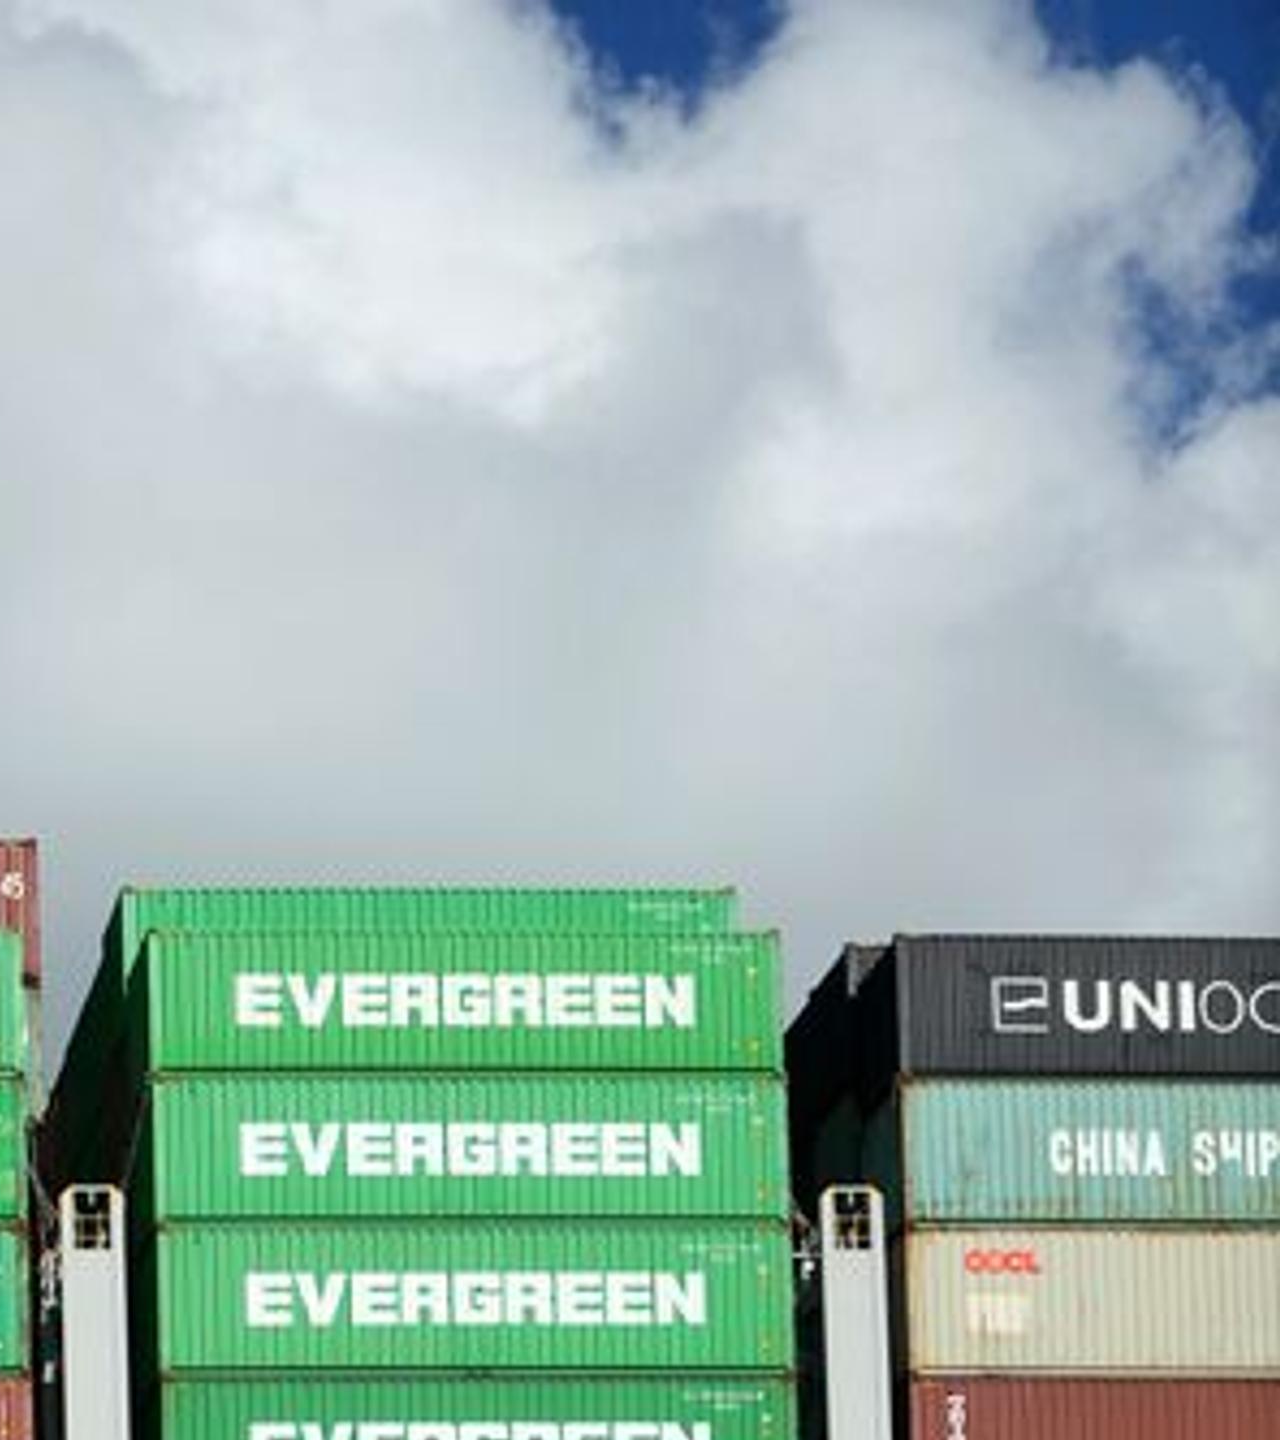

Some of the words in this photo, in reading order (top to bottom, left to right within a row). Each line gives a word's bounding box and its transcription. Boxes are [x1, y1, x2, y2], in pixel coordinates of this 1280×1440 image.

[235, 973, 694, 1027] EVERGREEN
[239, 1122, 701, 1176] EVERGREEN
[1051, 1130, 1165, 1175] CHINA
[965, 1249, 1041, 1274] OOCL
[245, 1271, 705, 1327] EVERGREEN
